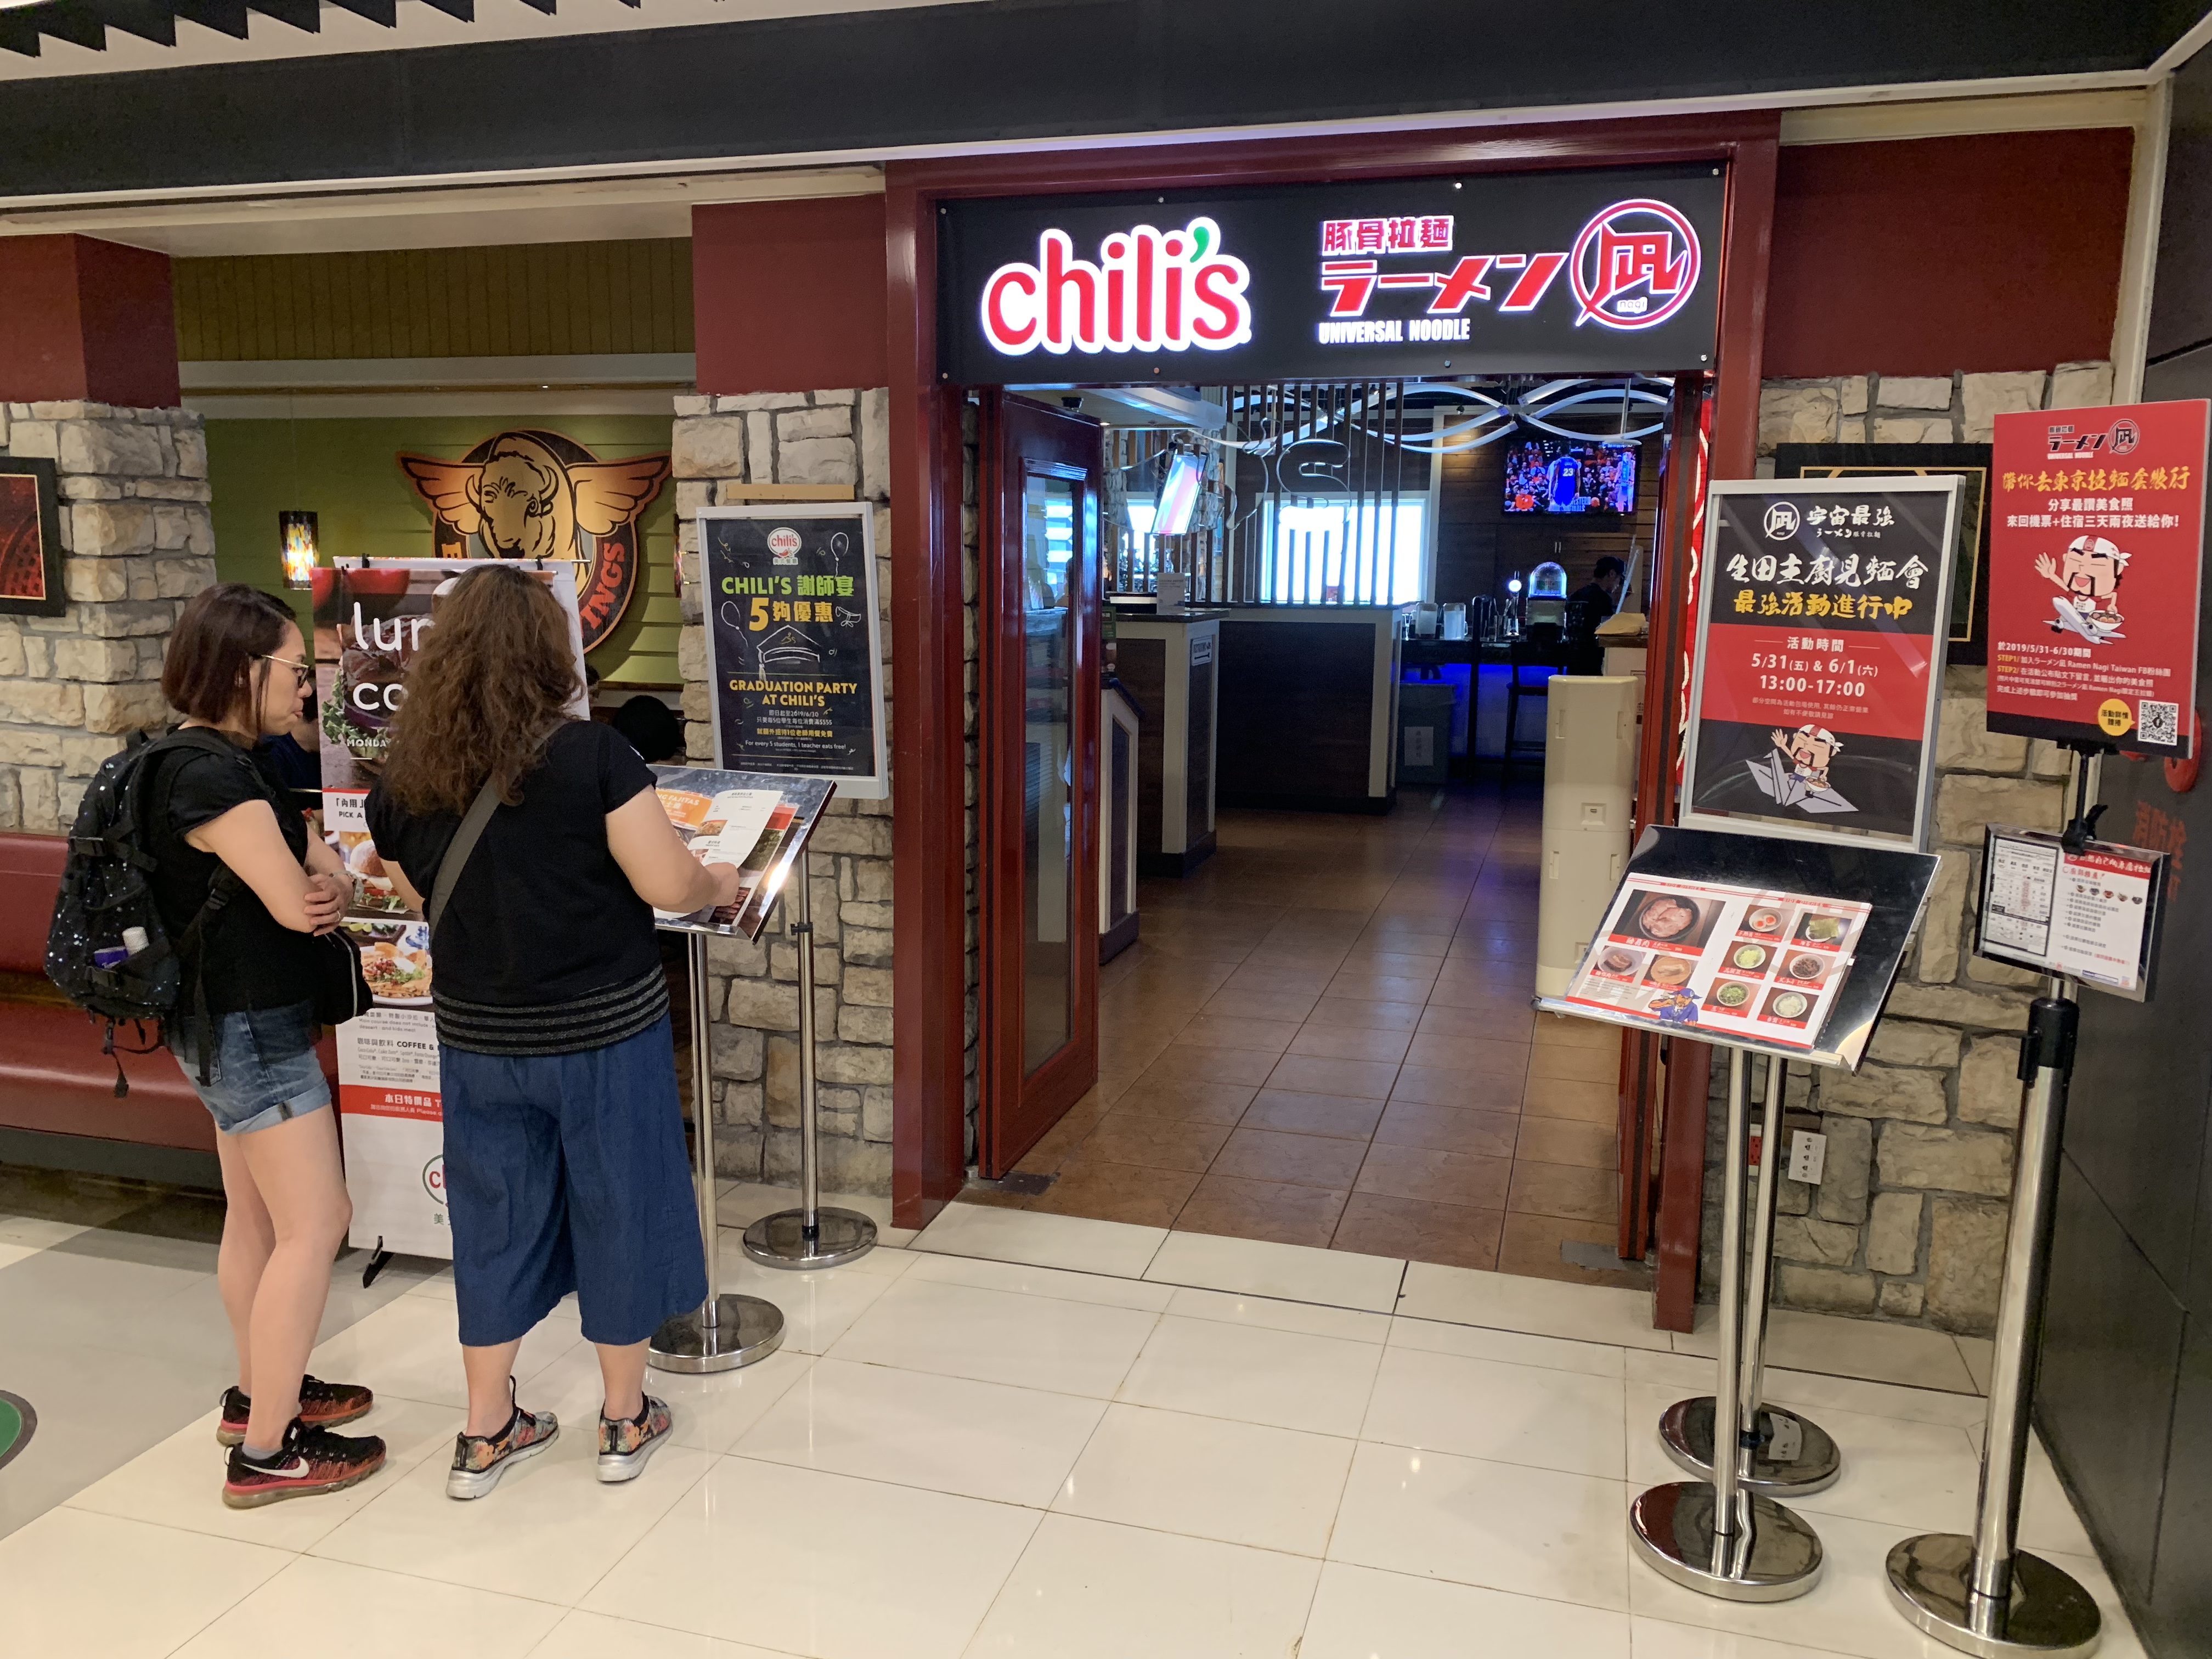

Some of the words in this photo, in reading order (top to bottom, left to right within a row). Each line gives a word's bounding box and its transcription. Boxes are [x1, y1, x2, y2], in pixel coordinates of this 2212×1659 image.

[1323, 217, 1454, 255] 豚骨拉麵
[985, 221, 1246, 351] chili's
[1322, 253, 1570, 317] ラーメン
[1319, 321, 1403, 344] UNIVERSAL
[1409, 319, 1470, 341] NOODLE
[2048, 433, 2108, 452] ラーメン
[1807, 504, 1895, 527] 宇宙最強
[2048, 497, 2134, 512] 分享最讚美食照
[771, 534, 798, 547] chili's
[1726, 552, 1928, 590] 生田主廚見麵會
[579, 542, 625, 630] INGS
[721, 576, 792, 595] CHILI'S
[797, 575, 854, 597] 謝師宴
[1734, 589, 1913, 620] 最強活動進行中
[1787, 636, 1844, 652] 活動時間
[1751, 653, 1809, 672] 5/31(五)
[1813, 660, 1822, 672] &
[1829, 658, 1878, 678] 6/1(六)
[2068, 660, 2091, 669] Ramen
[2093, 663, 2109, 672] Nagi
[2111, 664, 2136, 673] Taiwan
[729, 680, 814, 693] GRADUATION
[816, 682, 857, 694] PARTY
[1760, 675, 1865, 697] 13:00-17:00
[762, 694, 777, 705] AT
[780, 695, 825, 707] CHILI'S
[397, 1041, 426, 1049] COFFEE
[385, 1093, 432, 1108] 本日特價品
